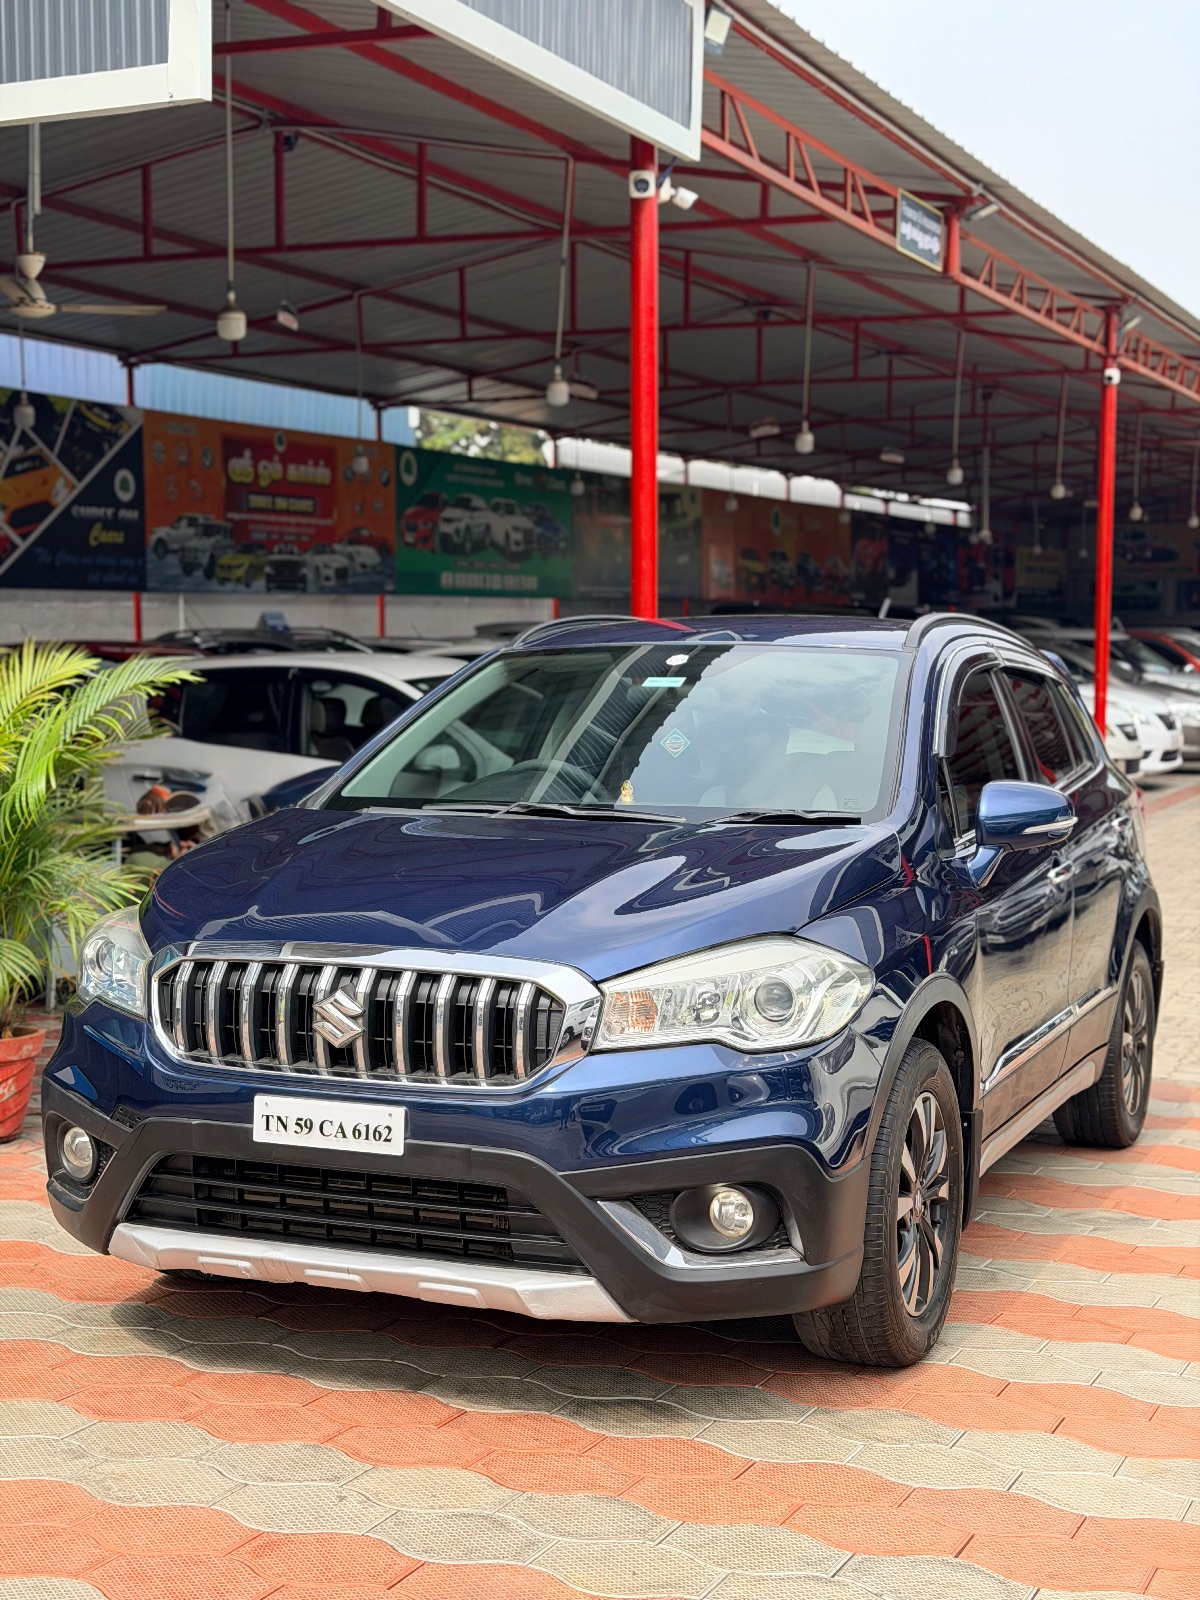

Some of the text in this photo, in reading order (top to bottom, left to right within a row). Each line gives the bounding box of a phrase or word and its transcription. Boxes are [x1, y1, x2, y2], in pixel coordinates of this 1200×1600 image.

[261, 1114, 393, 1143] TN 59 CA 6162
